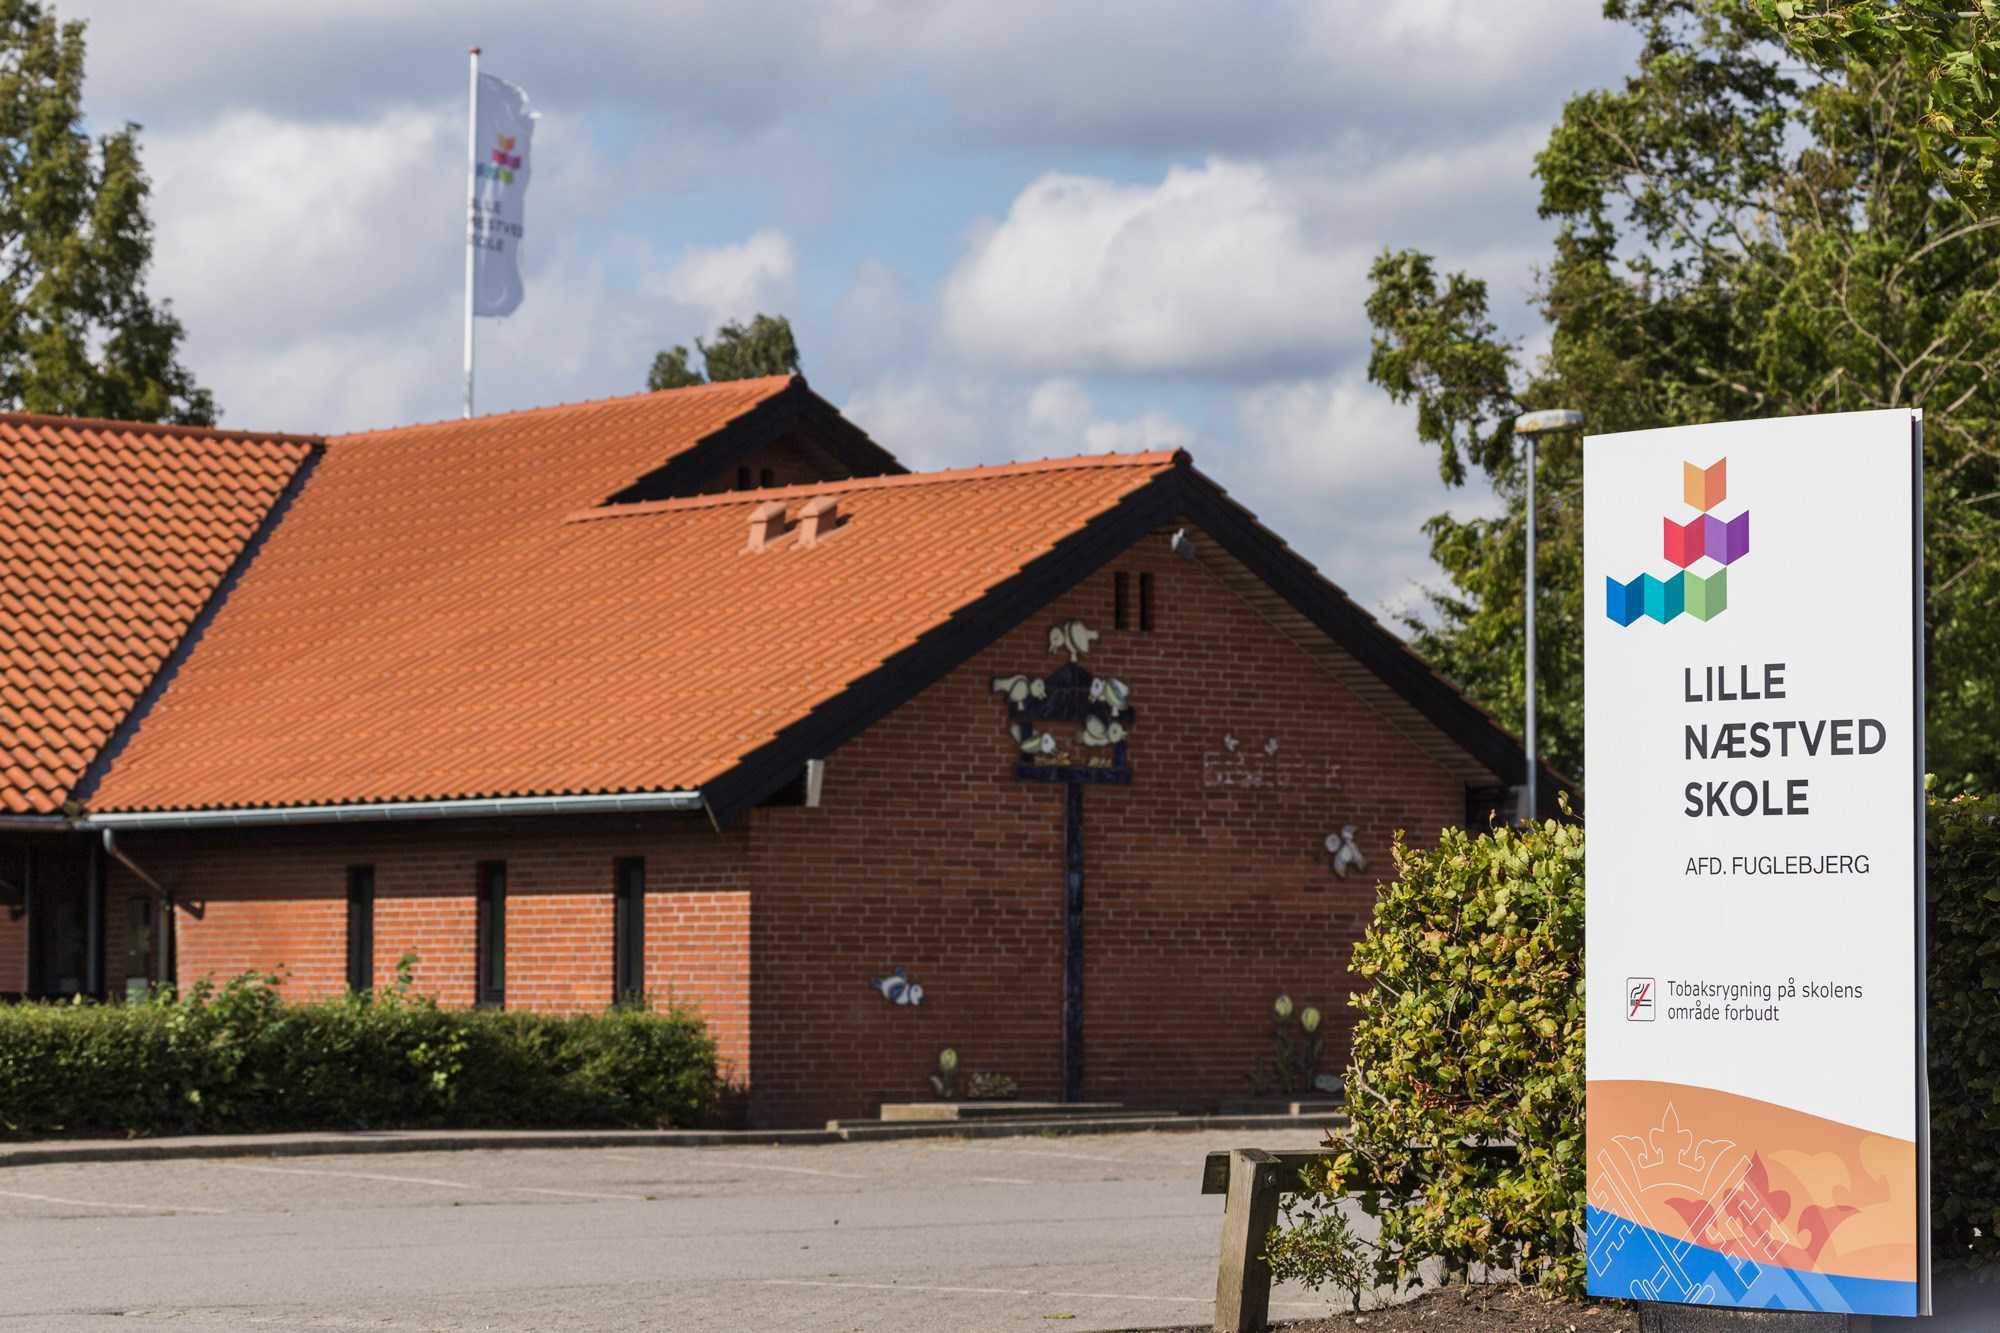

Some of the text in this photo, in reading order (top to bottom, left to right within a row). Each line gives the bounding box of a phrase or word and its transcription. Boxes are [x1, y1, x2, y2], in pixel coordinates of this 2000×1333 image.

[1684, 662, 1787, 703] LILLE
[1684, 718, 1887, 761] NÆSTVED
[1684, 779, 1809, 818] SKOLE
[1685, 855, 1870, 876] AFD. FUGLEBJERG
[1667, 976, 1863, 1000] Tobaksrygning på skolens
[1667, 999, 1780, 1022] område forbudt
